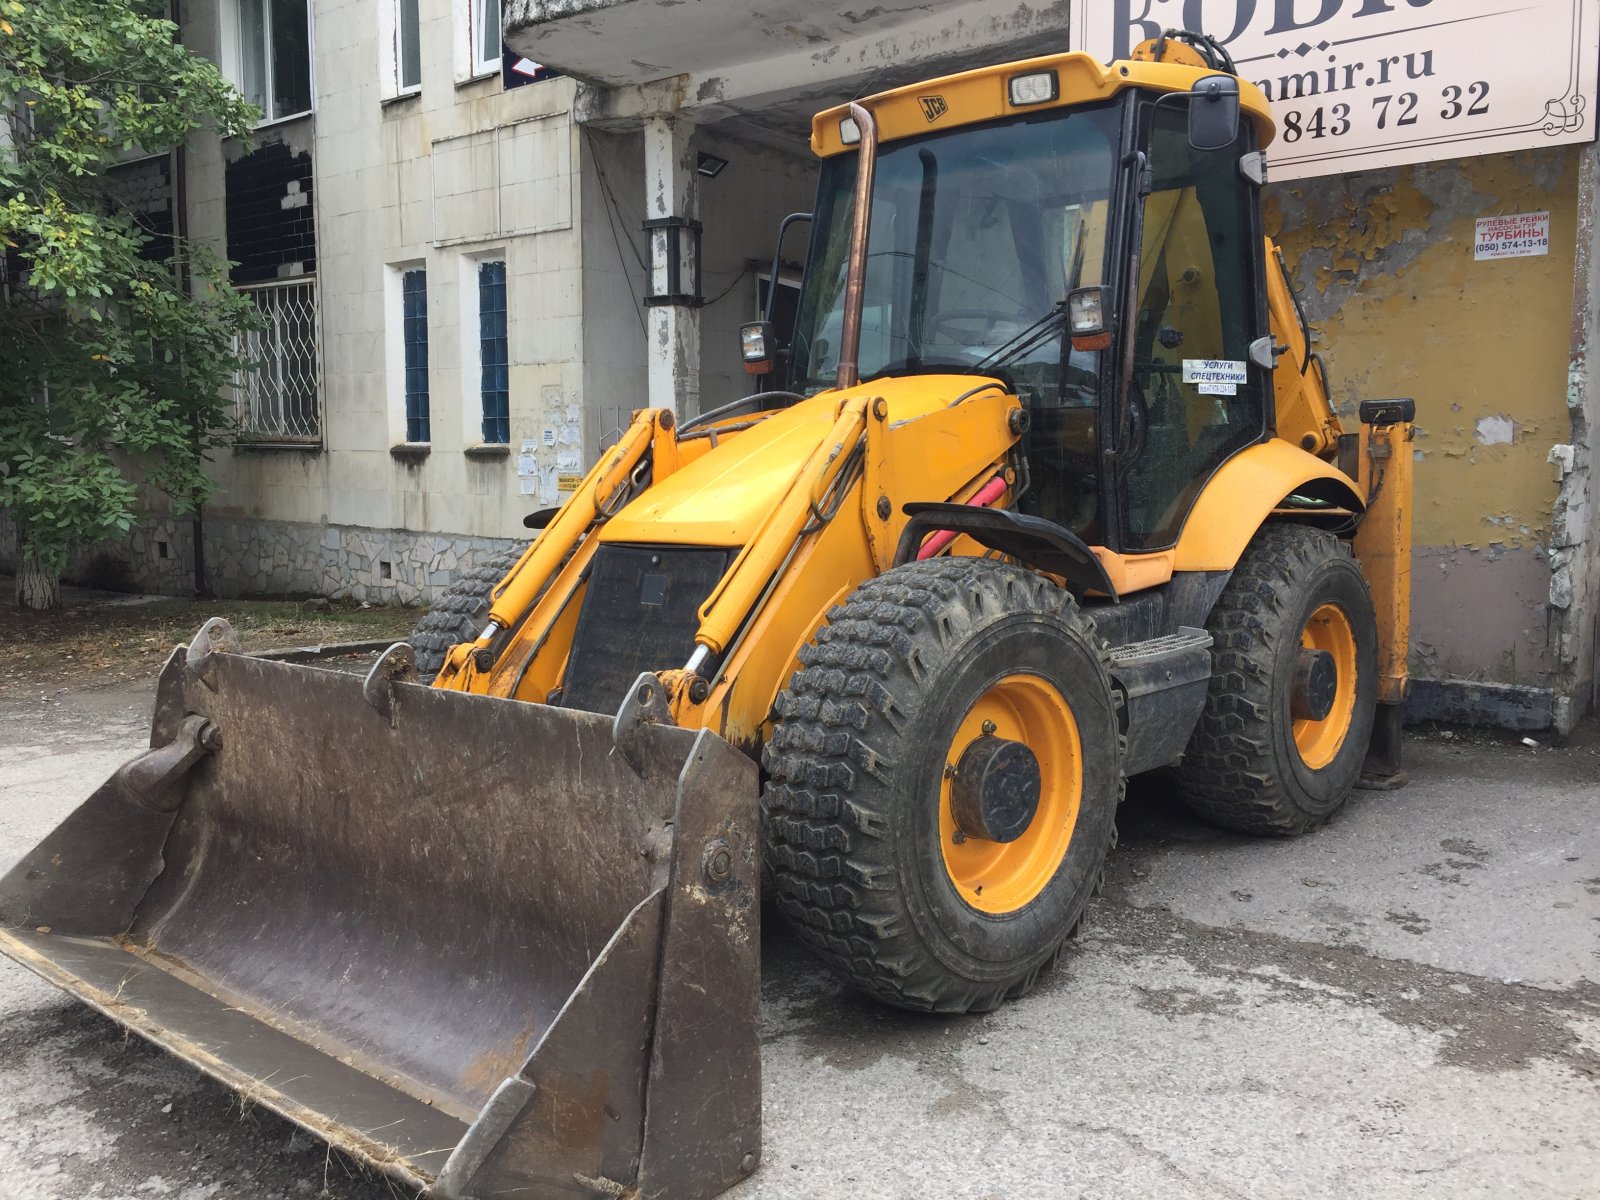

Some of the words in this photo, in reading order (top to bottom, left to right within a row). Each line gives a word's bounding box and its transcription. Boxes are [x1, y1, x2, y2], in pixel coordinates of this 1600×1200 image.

[923, 97, 946, 120] JCB
[1283, 102, 1351, 143] 843
[1372, 91, 1419, 130] 72
[1440, 80, 1490, 120] 32
[1476, 217, 1518, 228] РУЛЕВЫЕ
[1520, 214, 1549, 223] РЕЙКИ
[1488, 224, 1521, 232] НАСОСЫ
[1480, 228, 1544, 242] ТУРБИНЫ
[1475, 243, 1499, 253] (050)
[1502, 238, 1548, 249] 574-13-18
[1204, 361, 1233, 370] УСЛУГИ
[1190, 372, 1245, 381] СПЕЦТЕХНИКИ
